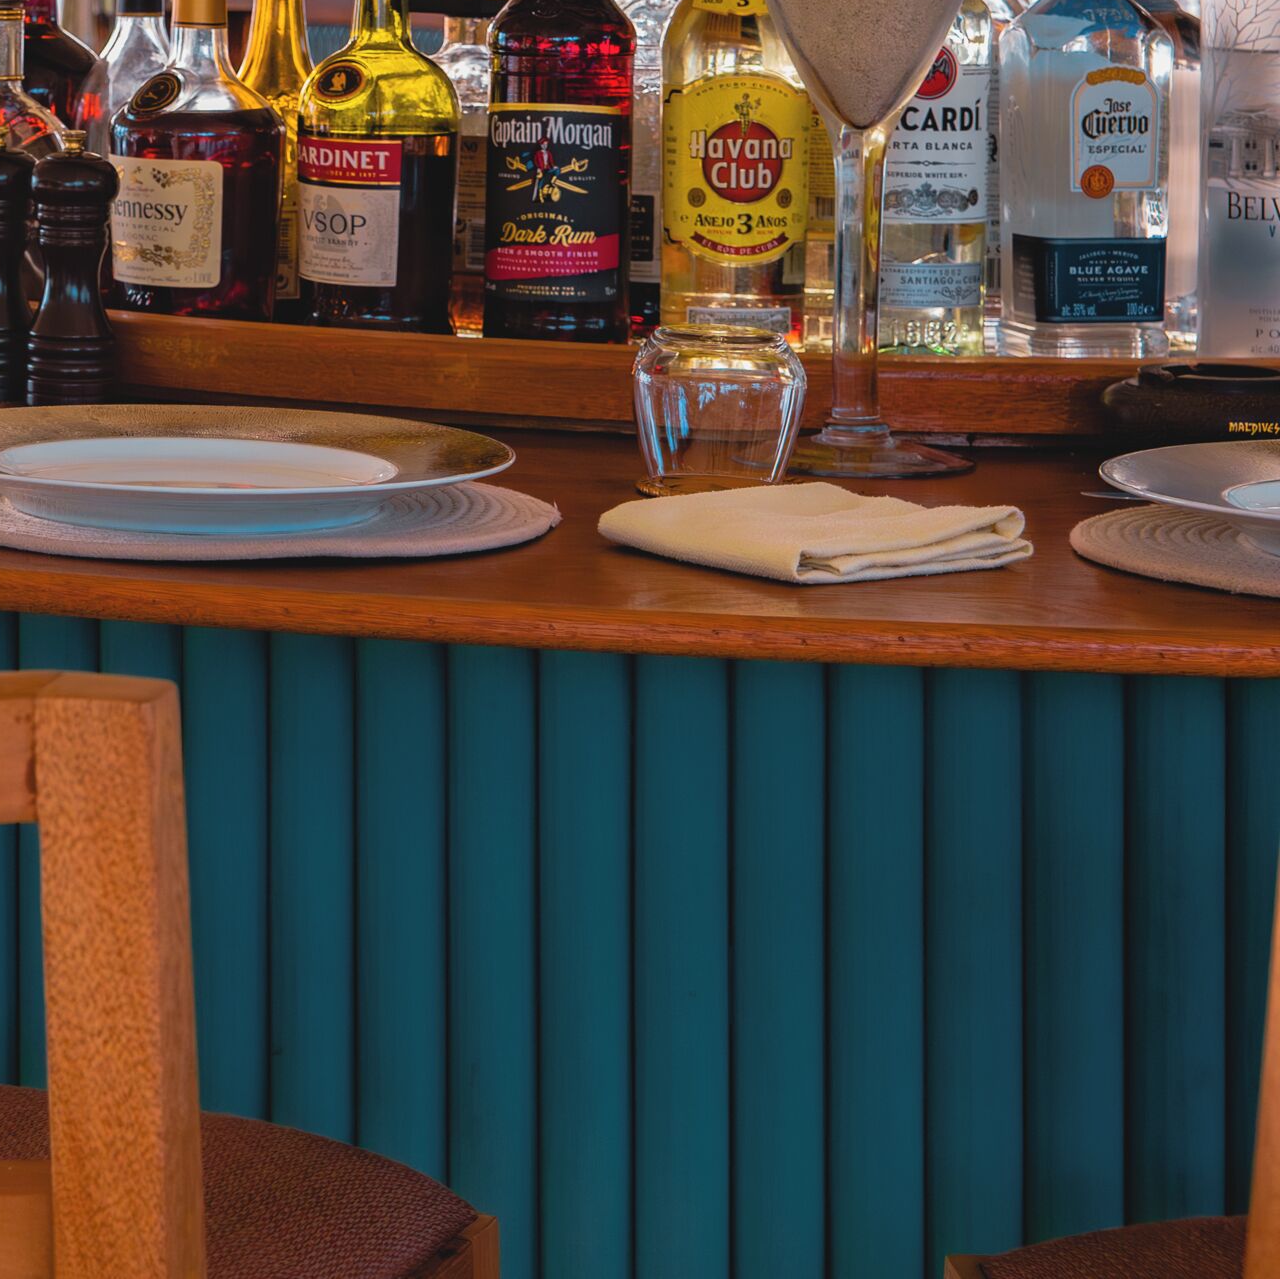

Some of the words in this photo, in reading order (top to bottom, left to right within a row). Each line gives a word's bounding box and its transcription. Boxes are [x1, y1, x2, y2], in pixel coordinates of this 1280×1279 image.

[895, 99, 982, 131] CARDÍ
[1104, 98, 1132, 116] Jose
[491, 115, 543, 149] Captain
[541, 116, 613, 150] Morgan
[1081, 109, 1149, 140] Cuervo
[689, 129, 795, 160] Havana
[888, 141, 920, 151] RTA
[925, 142, 974, 151] BLANCA
[1087, 144, 1146, 155] ESPECIAL
[711, 162, 773, 190] Club
[303, 208, 367, 236] VSOP
[520, 211, 569, 223] ORIGINAL
[694, 213, 735, 228] AÑEJO
[736, 213, 753, 235] 3
[755, 215, 788, 228] AÑOS
[500, 221, 548, 244] Dark
[549, 224, 597, 248] Rum
[524, 249, 563, 258] SMOOTH
[899, 275, 955, 285] SANTIAGO
[1069, 266, 1102, 275] BLUE
[1106, 265, 1149, 275] AGAVE
